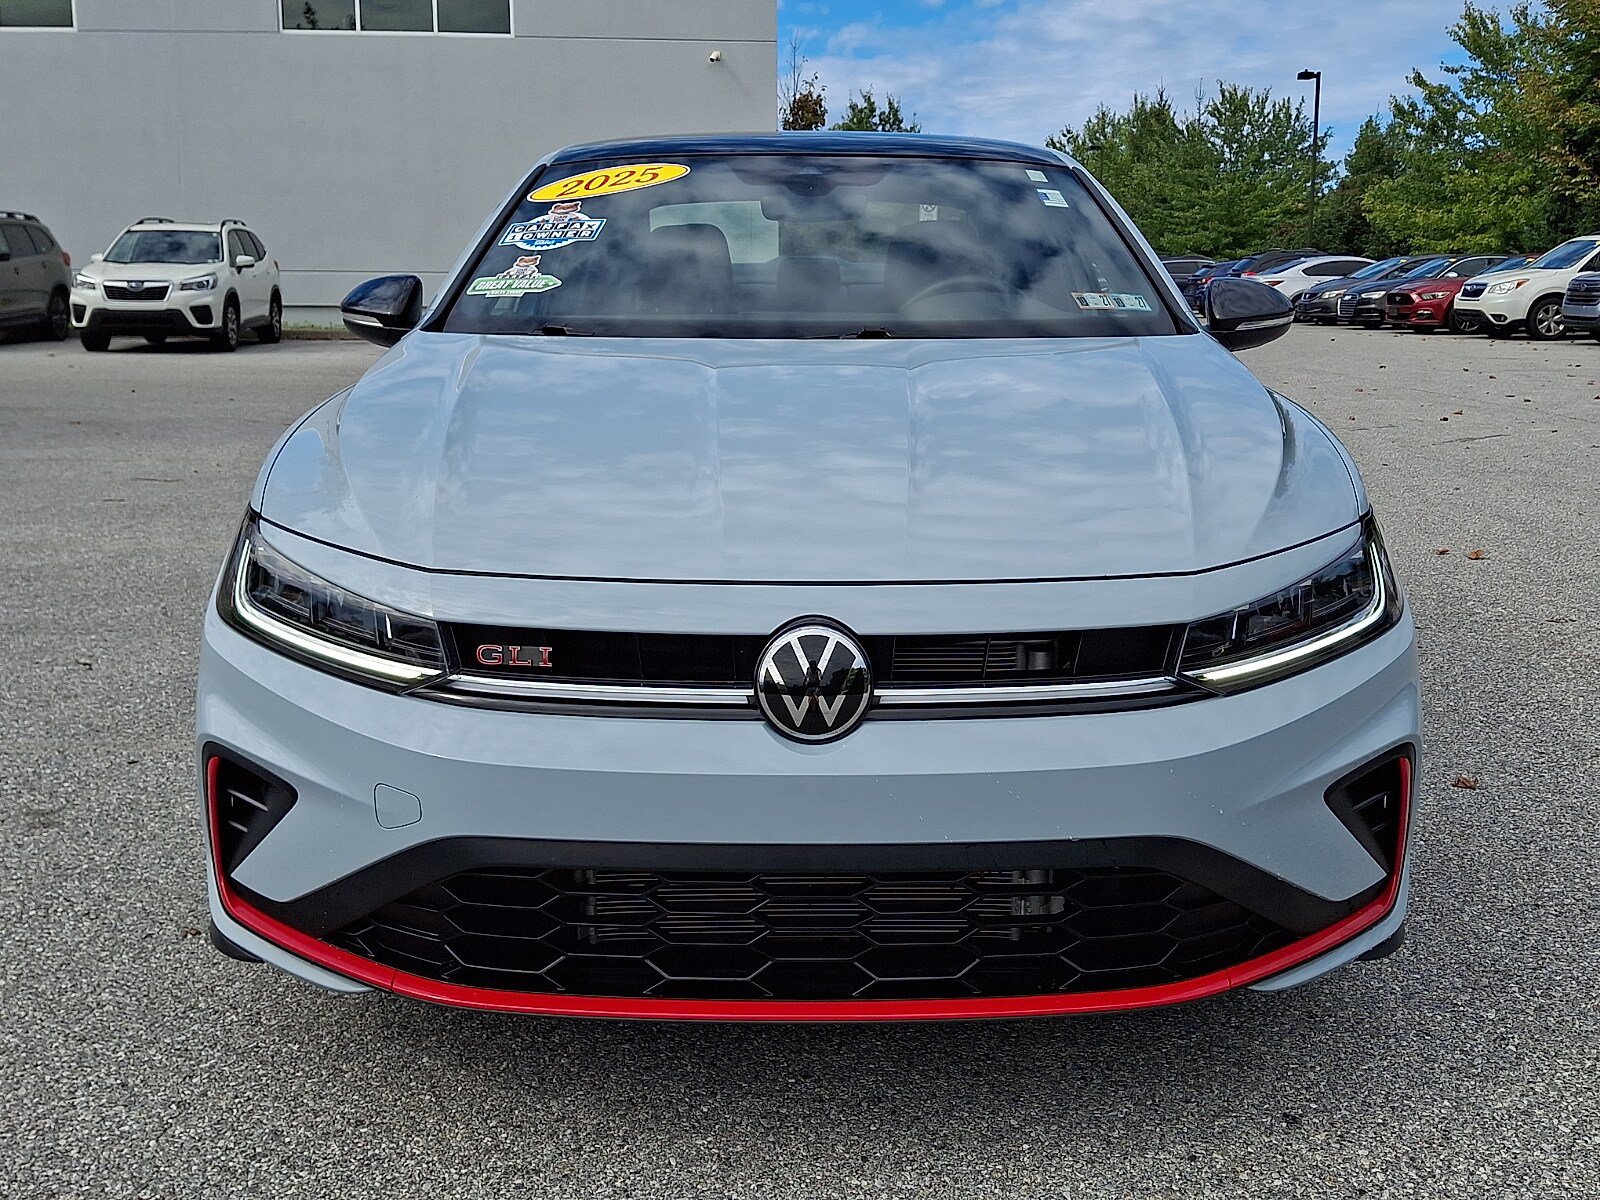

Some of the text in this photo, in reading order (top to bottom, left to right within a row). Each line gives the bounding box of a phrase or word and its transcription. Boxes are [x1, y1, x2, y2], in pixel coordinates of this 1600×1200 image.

[556, 167, 663, 197] 2025
[513, 222, 597, 233] CARFAX
[509, 230, 591, 241] 1 OWNER
[475, 279, 546, 290] GREAT VALUE
[1076, 295, 1112, 307] 10 27
[1113, 297, 1147, 308] 10 27
[476, 644, 553, 667] GLI
[759, 628, 869, 736] VW
